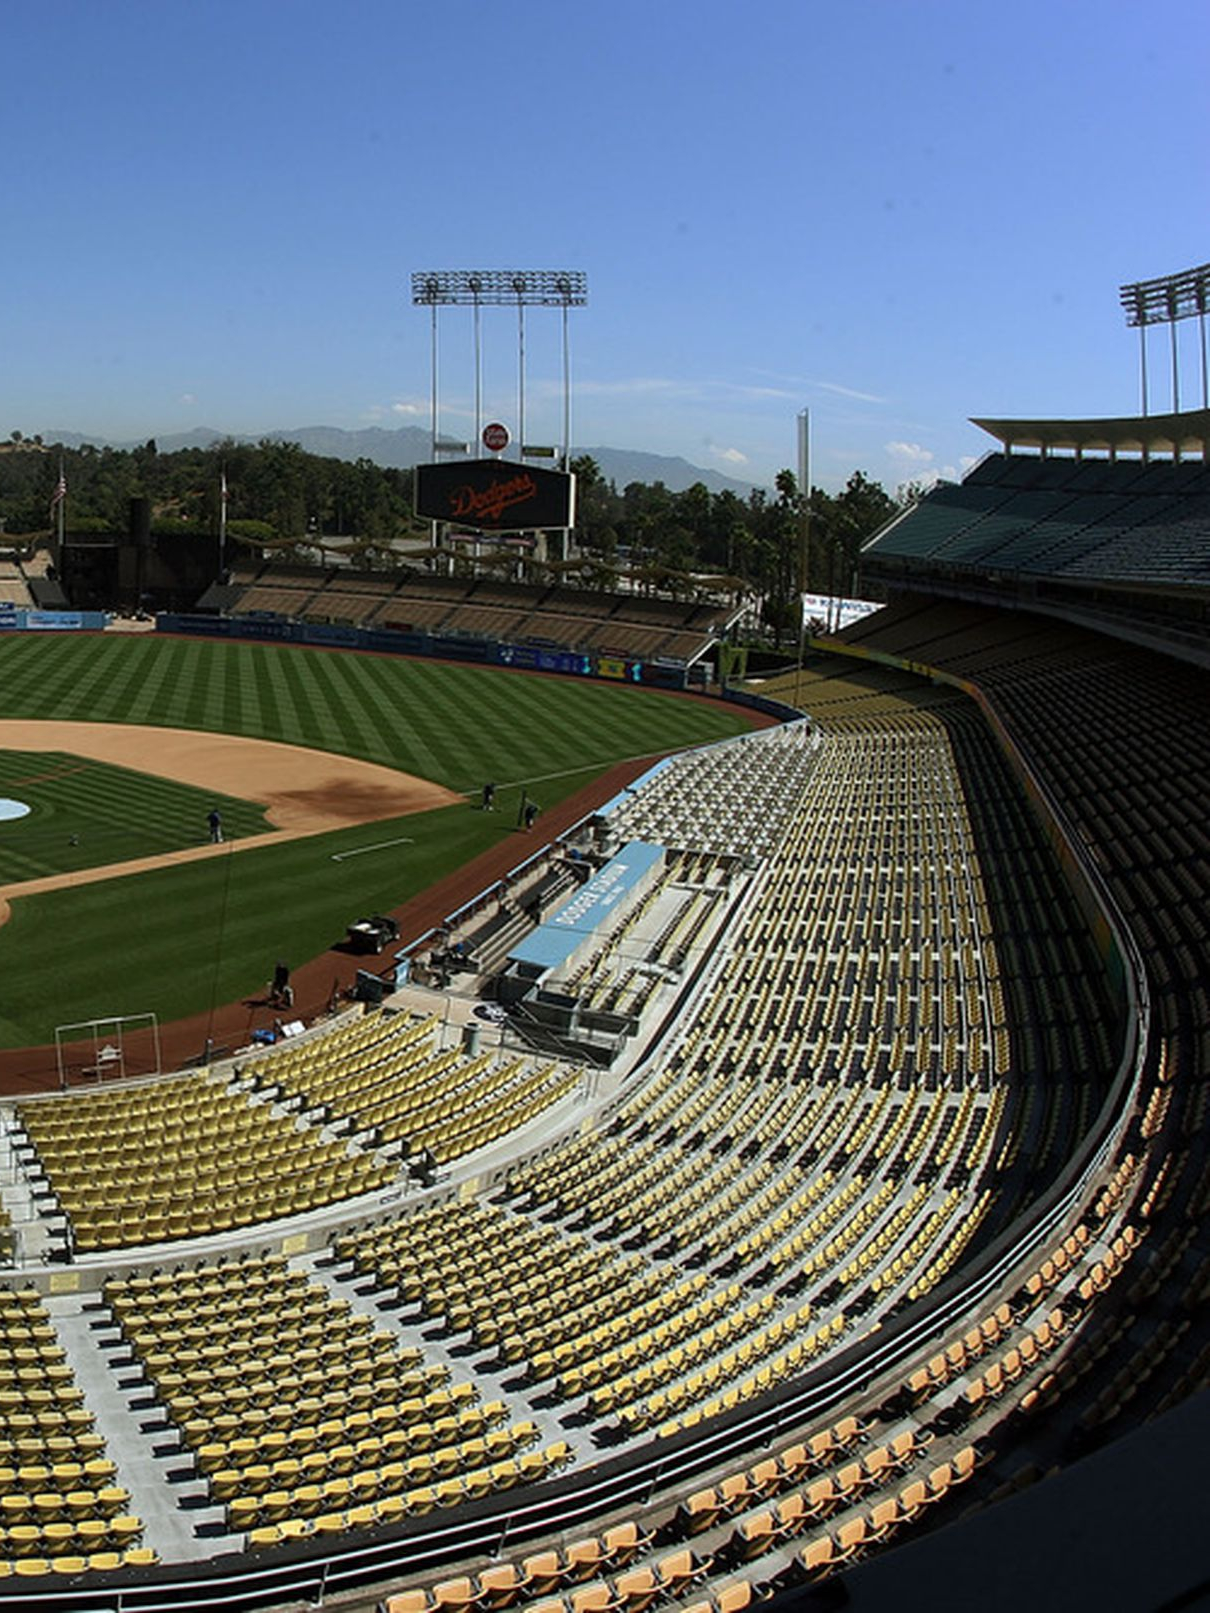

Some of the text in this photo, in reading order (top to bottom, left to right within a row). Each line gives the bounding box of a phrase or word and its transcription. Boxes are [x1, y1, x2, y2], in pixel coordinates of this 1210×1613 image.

[450, 472, 536, 518] Dodgers
[555, 890, 601, 925] DODGER
[590, 863, 630, 893] STADIUM
